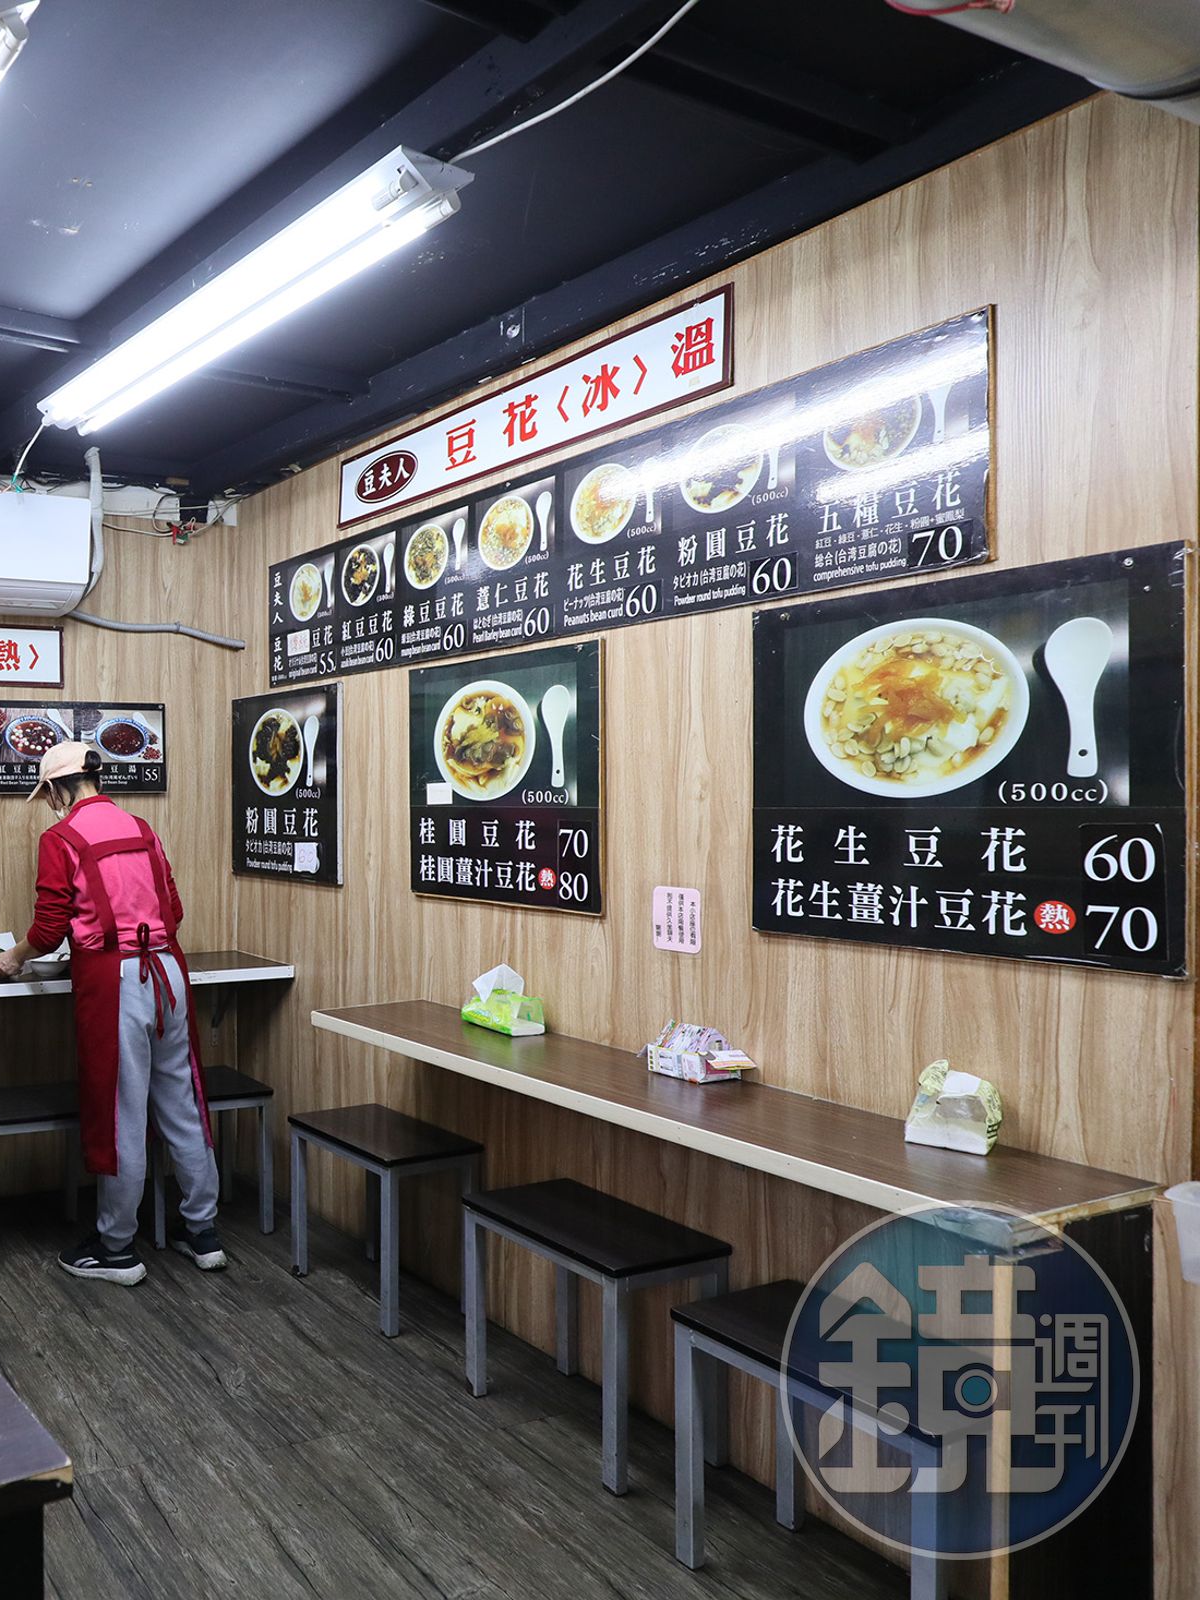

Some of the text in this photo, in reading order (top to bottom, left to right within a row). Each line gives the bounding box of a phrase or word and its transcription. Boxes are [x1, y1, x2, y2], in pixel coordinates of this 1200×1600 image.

[362, 457, 411, 496] 豆夫人
[751, 486, 789, 506] (500cc)
[627, 523, 657, 539] (500cc)
[677, 513, 789, 568] 粉圓豆花
[911, 525, 964, 567] 70
[524, 550, 550, 565] (500cc)
[566, 545, 657, 592] 花生豆花
[813, 557, 908, 583] comprehensive tofu pudding
[752, 557, 792, 595] 60
[272, 571, 284, 625] 豆夫人
[476, 571, 550, 612] 薏仁豆花
[625, 584, 657, 617] 60
[402, 592, 464, 628] 綠豆豆花
[524, 607, 550, 637] 60
[563, 603, 624, 627] Peanuts bean curd
[312, 625, 333, 648] 豆花
[341, 610, 393, 642] 紅豆豆花
[443, 623, 465, 651] 60
[272, 637, 284, 672] 豆花
[319, 651, 336, 675] 55
[375, 637, 394, 662] 60
[110, 764, 137, 773] 豆湯
[144, 769, 158, 782] 55
[295, 787, 321, 799] (500cc)
[521, 790, 569, 805] (500cc)
[998, 780, 1109, 805] (500cc)
[246, 807, 319, 837] 粉圓豆花
[419, 817, 537, 851] 桂圓豆花
[558, 828, 589, 858] 70
[771, 825, 1028, 874] 花生豆花
[419, 854, 537, 892] 桂圓薑汁豆花
[1083, 834, 1157, 884] 60
[558, 872, 589, 902] 80
[771, 878, 1072, 938] 花生薑汁豆花 熱
[1084, 905, 1159, 952] 70
